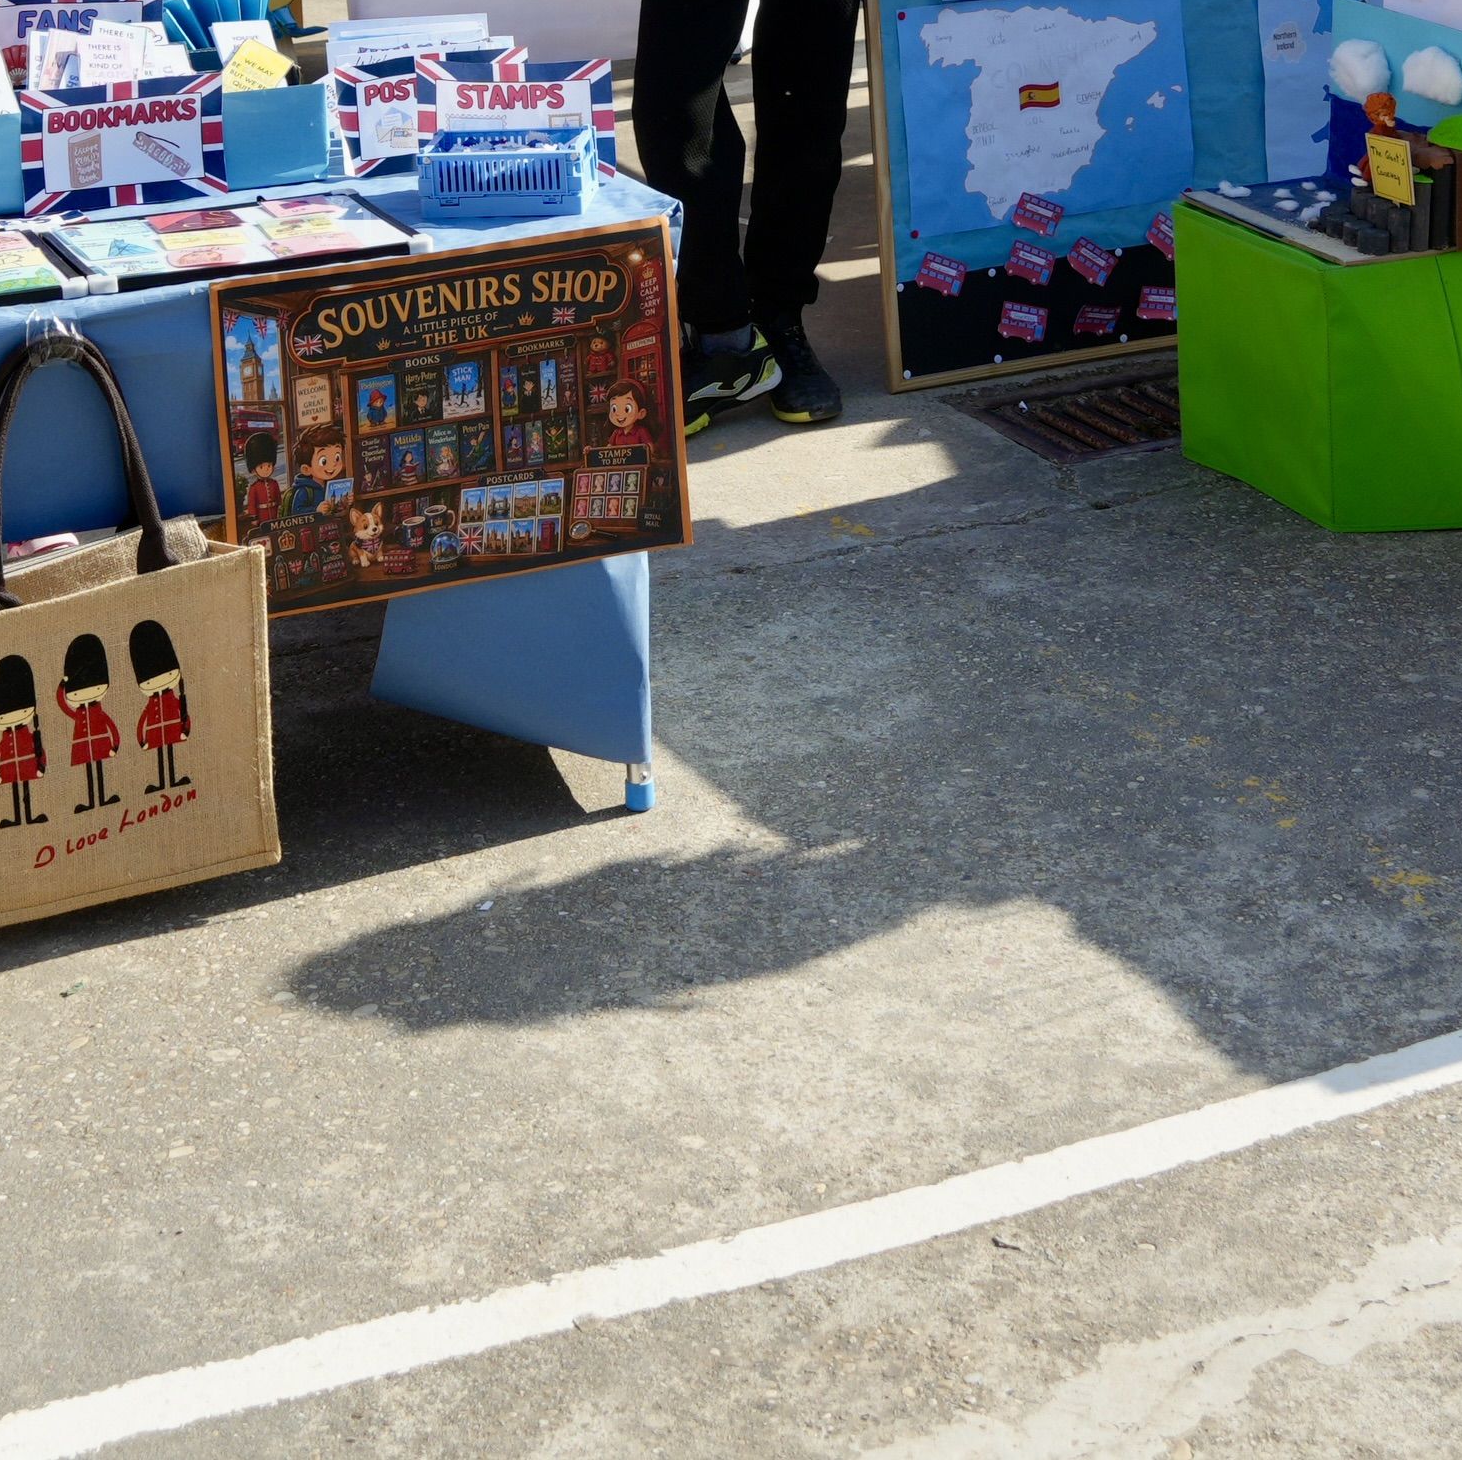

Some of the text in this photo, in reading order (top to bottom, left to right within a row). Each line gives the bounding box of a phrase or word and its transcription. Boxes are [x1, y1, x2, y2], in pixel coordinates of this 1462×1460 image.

[17, 9, 99, 38] FANS
[99, 28, 125, 38] THERE
[1273, 31, 1297, 41] Northern
[88, 44, 112, 52] THERE
[1277, 41, 1295, 51] Ireland
[457, 84, 565, 109] STAMPS
[47, 98, 197, 134] BOOKMARKS
[1371, 145, 1382, 159] The
[640, 278, 658, 289] KEEP
[640, 286, 660, 297] CALM
[317, 269, 618, 351] SOUVENIRS SHOP
[640, 299, 661, 311] CARRY
[645, 307, 656, 317] ON
[403, 312, 499, 335] A LITTLE PIECE OF
[422, 325, 489, 348] THE UK
[517, 339, 565, 354] BOOKMARKS
[405, 354, 441, 370] BOOKS
[452, 367, 473, 377] STICK
[454, 375, 472, 383] MAN
[303, 398, 324, 409] GREAT
[598, 449, 632, 459] STAMPS
[613, 457, 626, 465] BUY
[486, 471, 535, 486] POSTCARDS
[270, 514, 315, 531] MAGNETS
[119, 789, 196, 833] London
